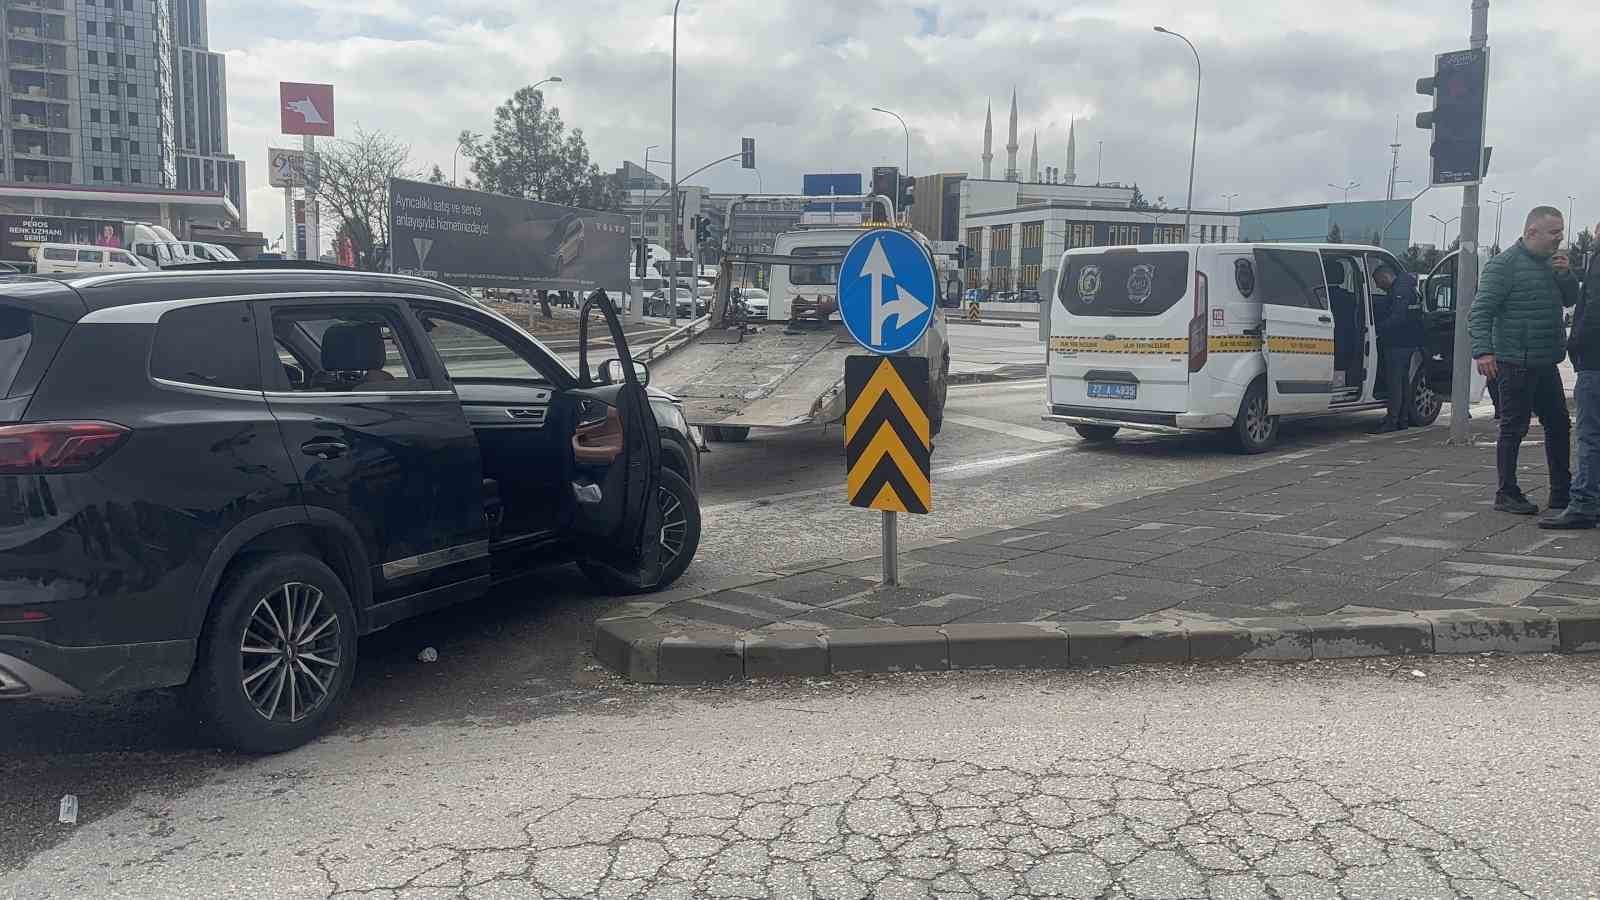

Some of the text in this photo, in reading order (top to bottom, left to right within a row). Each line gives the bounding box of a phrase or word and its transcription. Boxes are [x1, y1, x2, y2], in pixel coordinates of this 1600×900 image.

[461, 204, 482, 217] servis
[23, 220, 49, 228] PEROS
[9, 226, 31, 234] RENK
